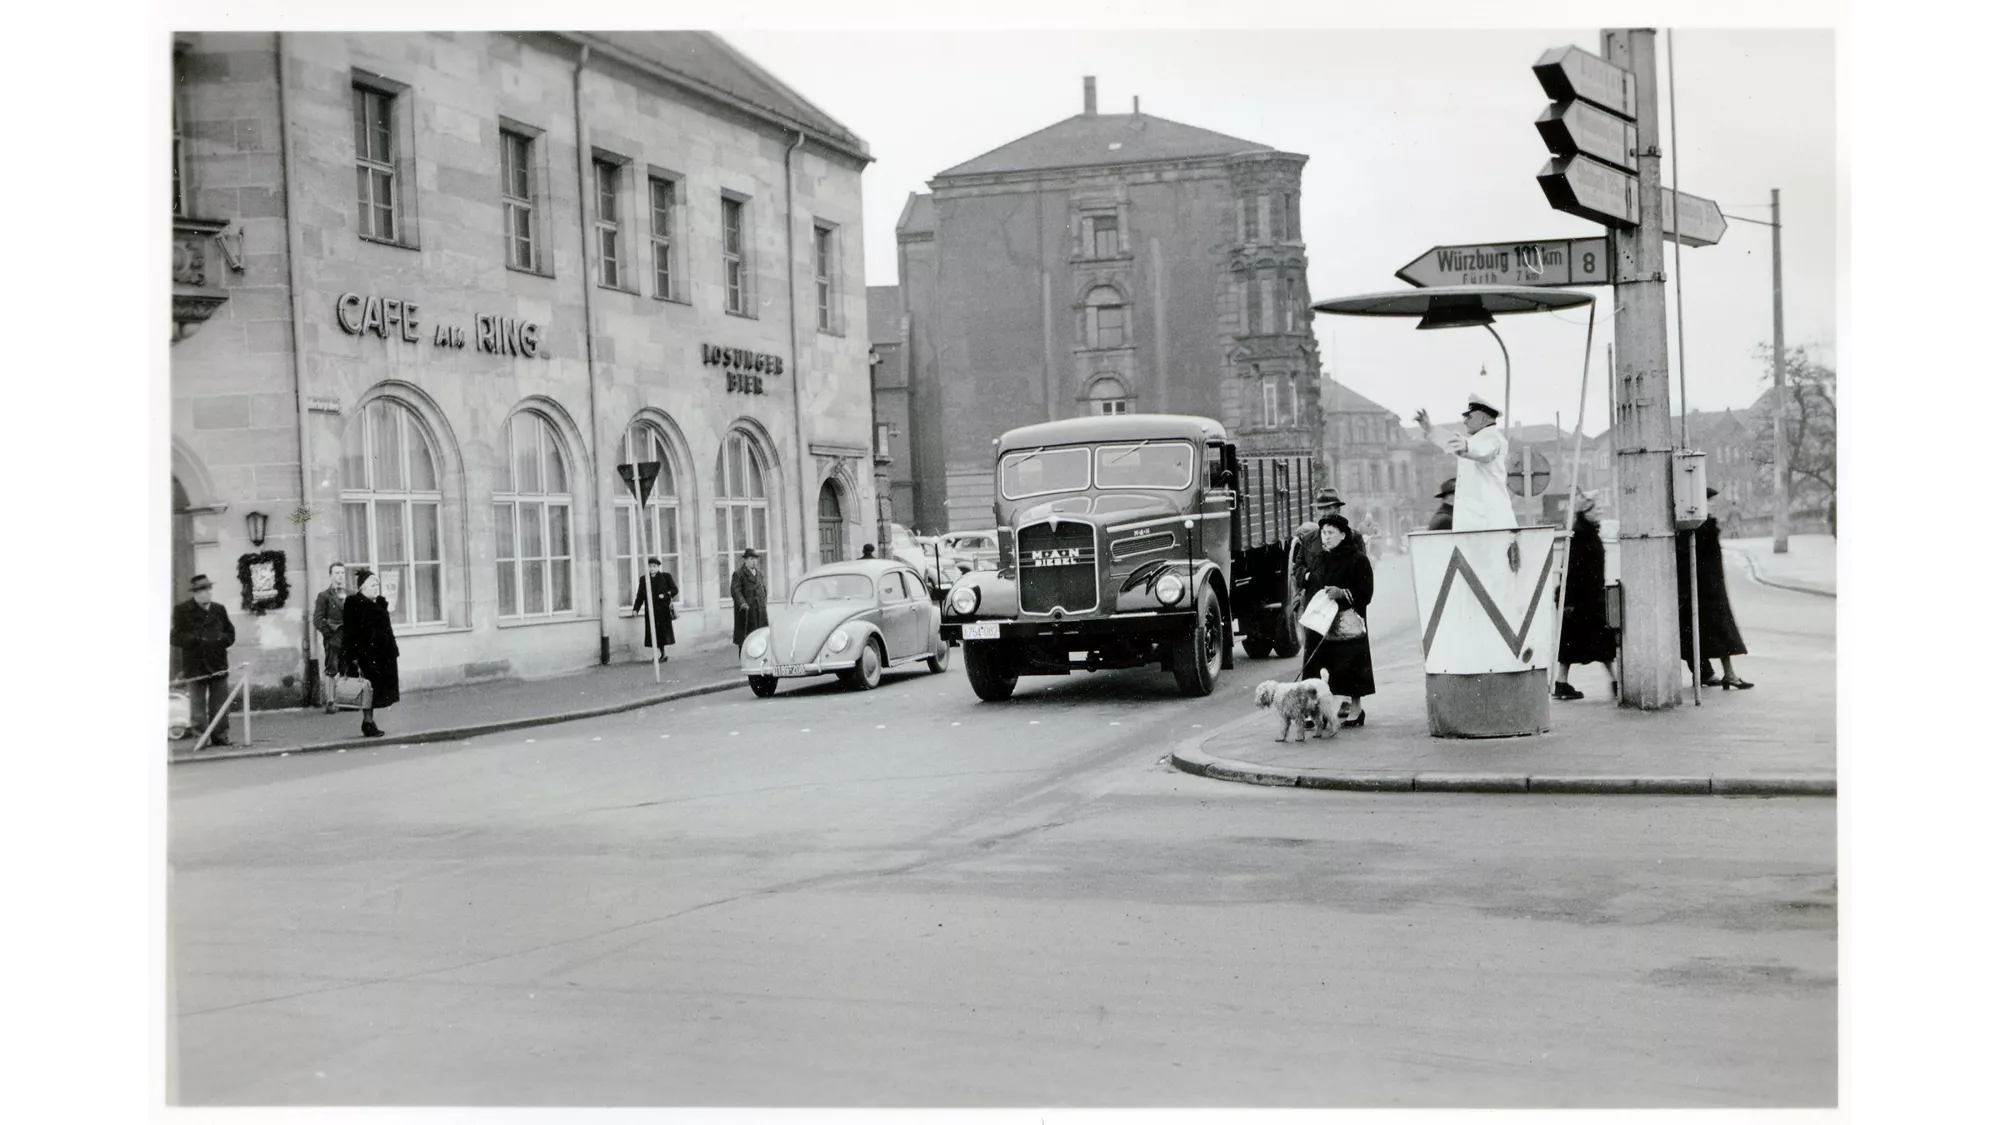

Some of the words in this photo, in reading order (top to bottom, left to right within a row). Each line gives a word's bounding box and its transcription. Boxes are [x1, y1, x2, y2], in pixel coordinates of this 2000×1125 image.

[1437, 247, 1509, 273] Würzburg
[1542, 246, 1563, 267] km
[1582, 251, 1596, 274] 8
[1462, 272, 1498, 285] Fürth
[1516, 270, 1523, 282] 7
[1525, 270, 1540, 281] km
[336, 292, 420, 344] CAFE
[474, 312, 538, 358] RING
[726, 371, 764, 395] BIER
[1034, 557, 1078, 567] DIESEL
